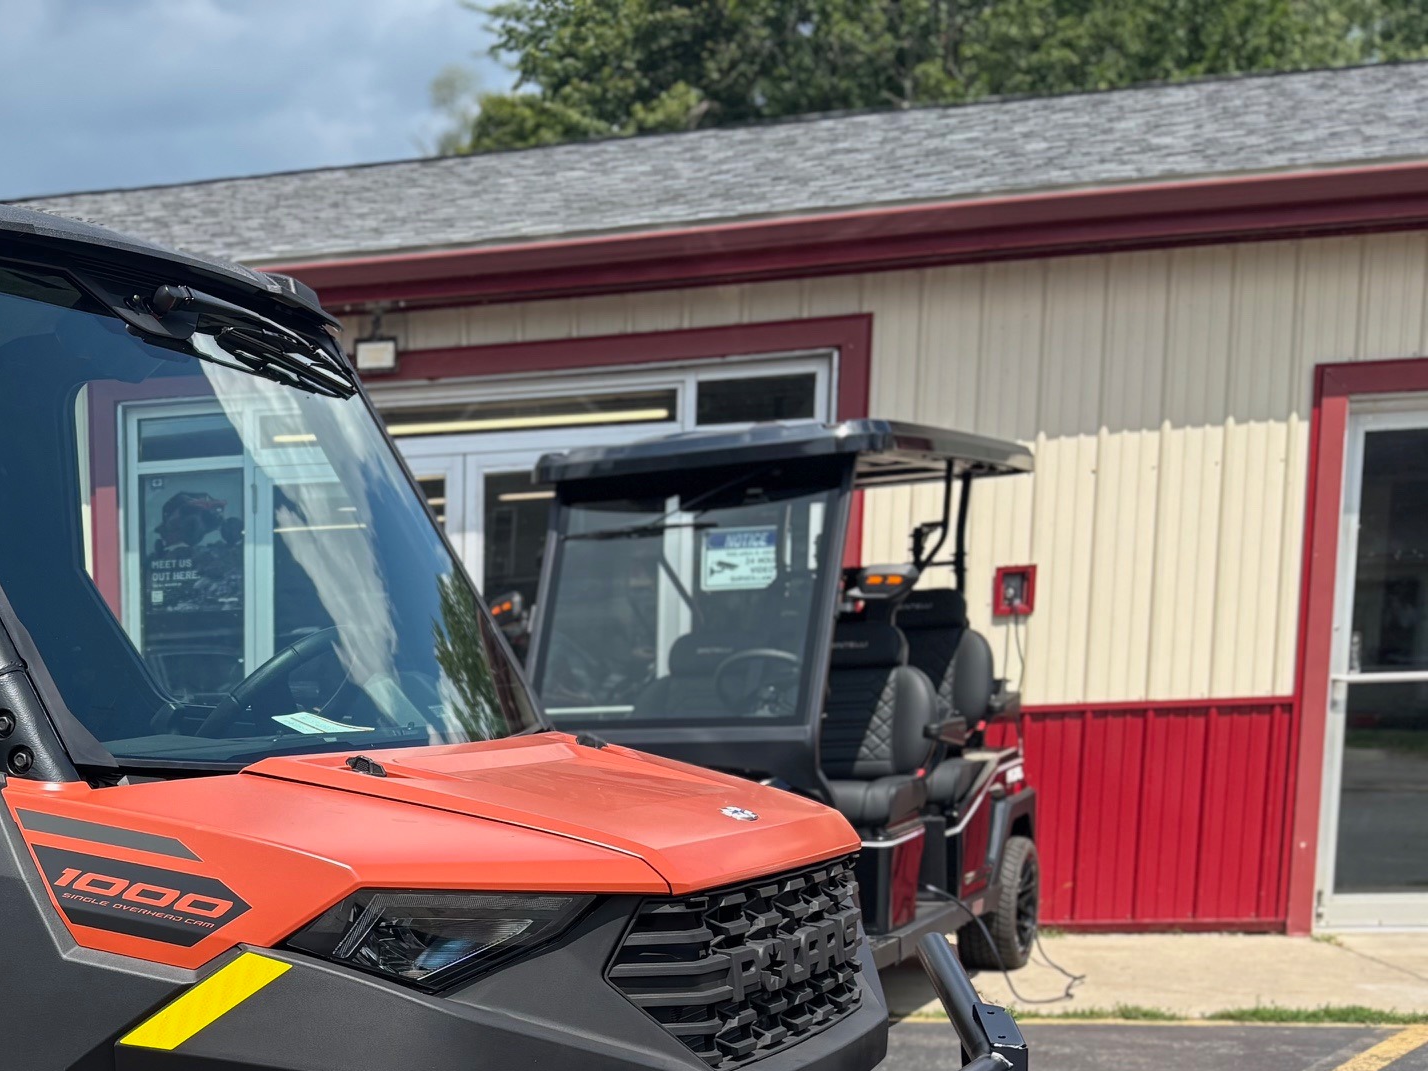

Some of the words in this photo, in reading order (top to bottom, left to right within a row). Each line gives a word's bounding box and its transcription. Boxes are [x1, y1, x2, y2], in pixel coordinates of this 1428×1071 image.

[723, 531, 769, 548] NOTICE
[151, 560, 176, 569] MEET
[178, 559, 192, 568] US
[152, 572, 170, 581] OUT
[53, 867, 234, 919] 1000
[61, 891, 112, 908] SINGLE
[112, 902, 184, 922] OVERHEAD
[184, 917, 216, 929] CAM
[731, 906, 863, 1002] POLARIS
